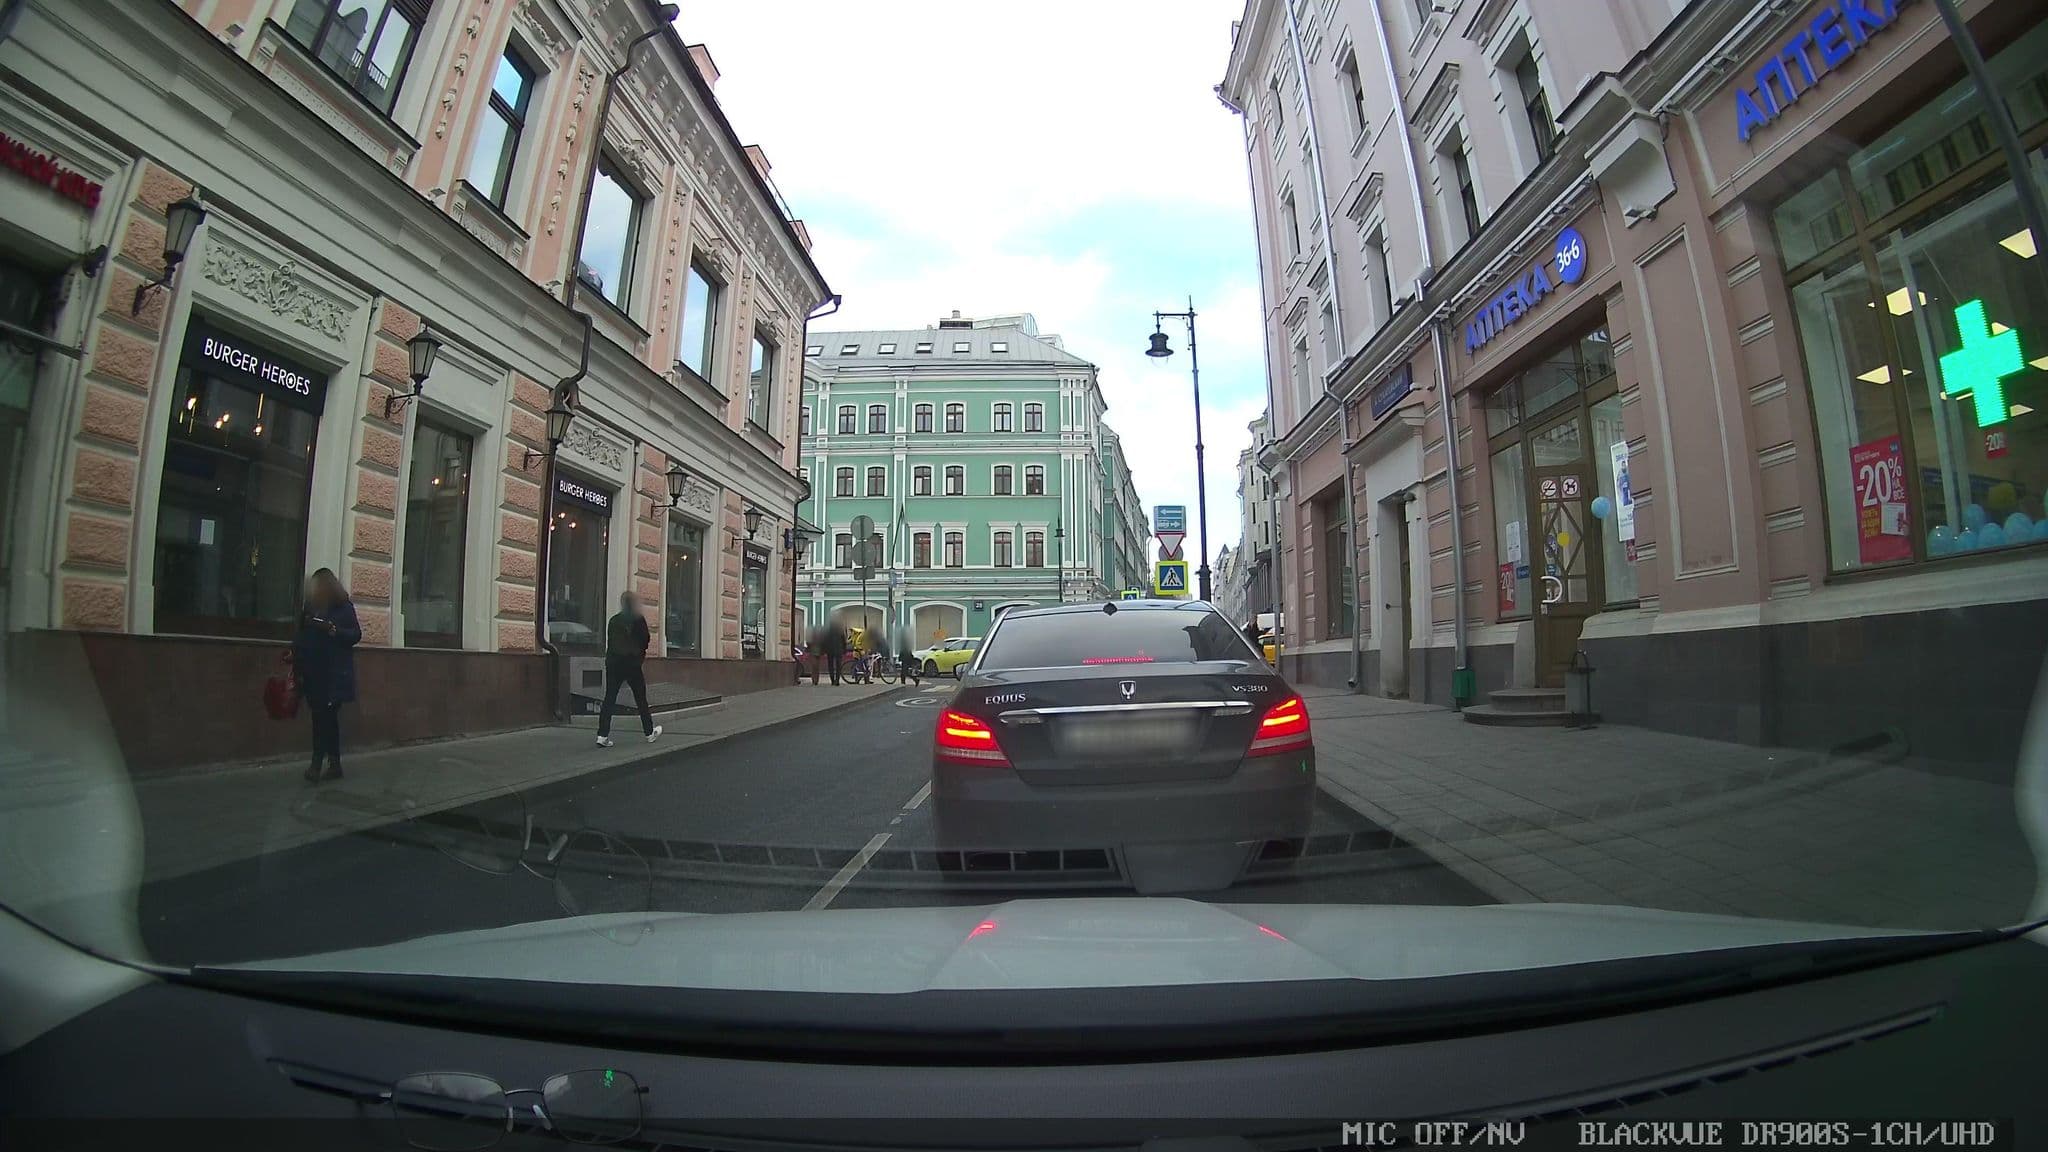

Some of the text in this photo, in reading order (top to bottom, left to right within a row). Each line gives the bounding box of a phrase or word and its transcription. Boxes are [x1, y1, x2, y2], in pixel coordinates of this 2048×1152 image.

[1734, 0, 1899, 143] АПТЕК
[1465, 261, 1554, 356] АПТЕКА
[204, 338, 311, 396] BURGER HEROES
[559, 480, 607, 508] BURGER HEROES
[1856, 455, 1903, 508] -20%
[985, 693, 1026, 705] EQUUS
